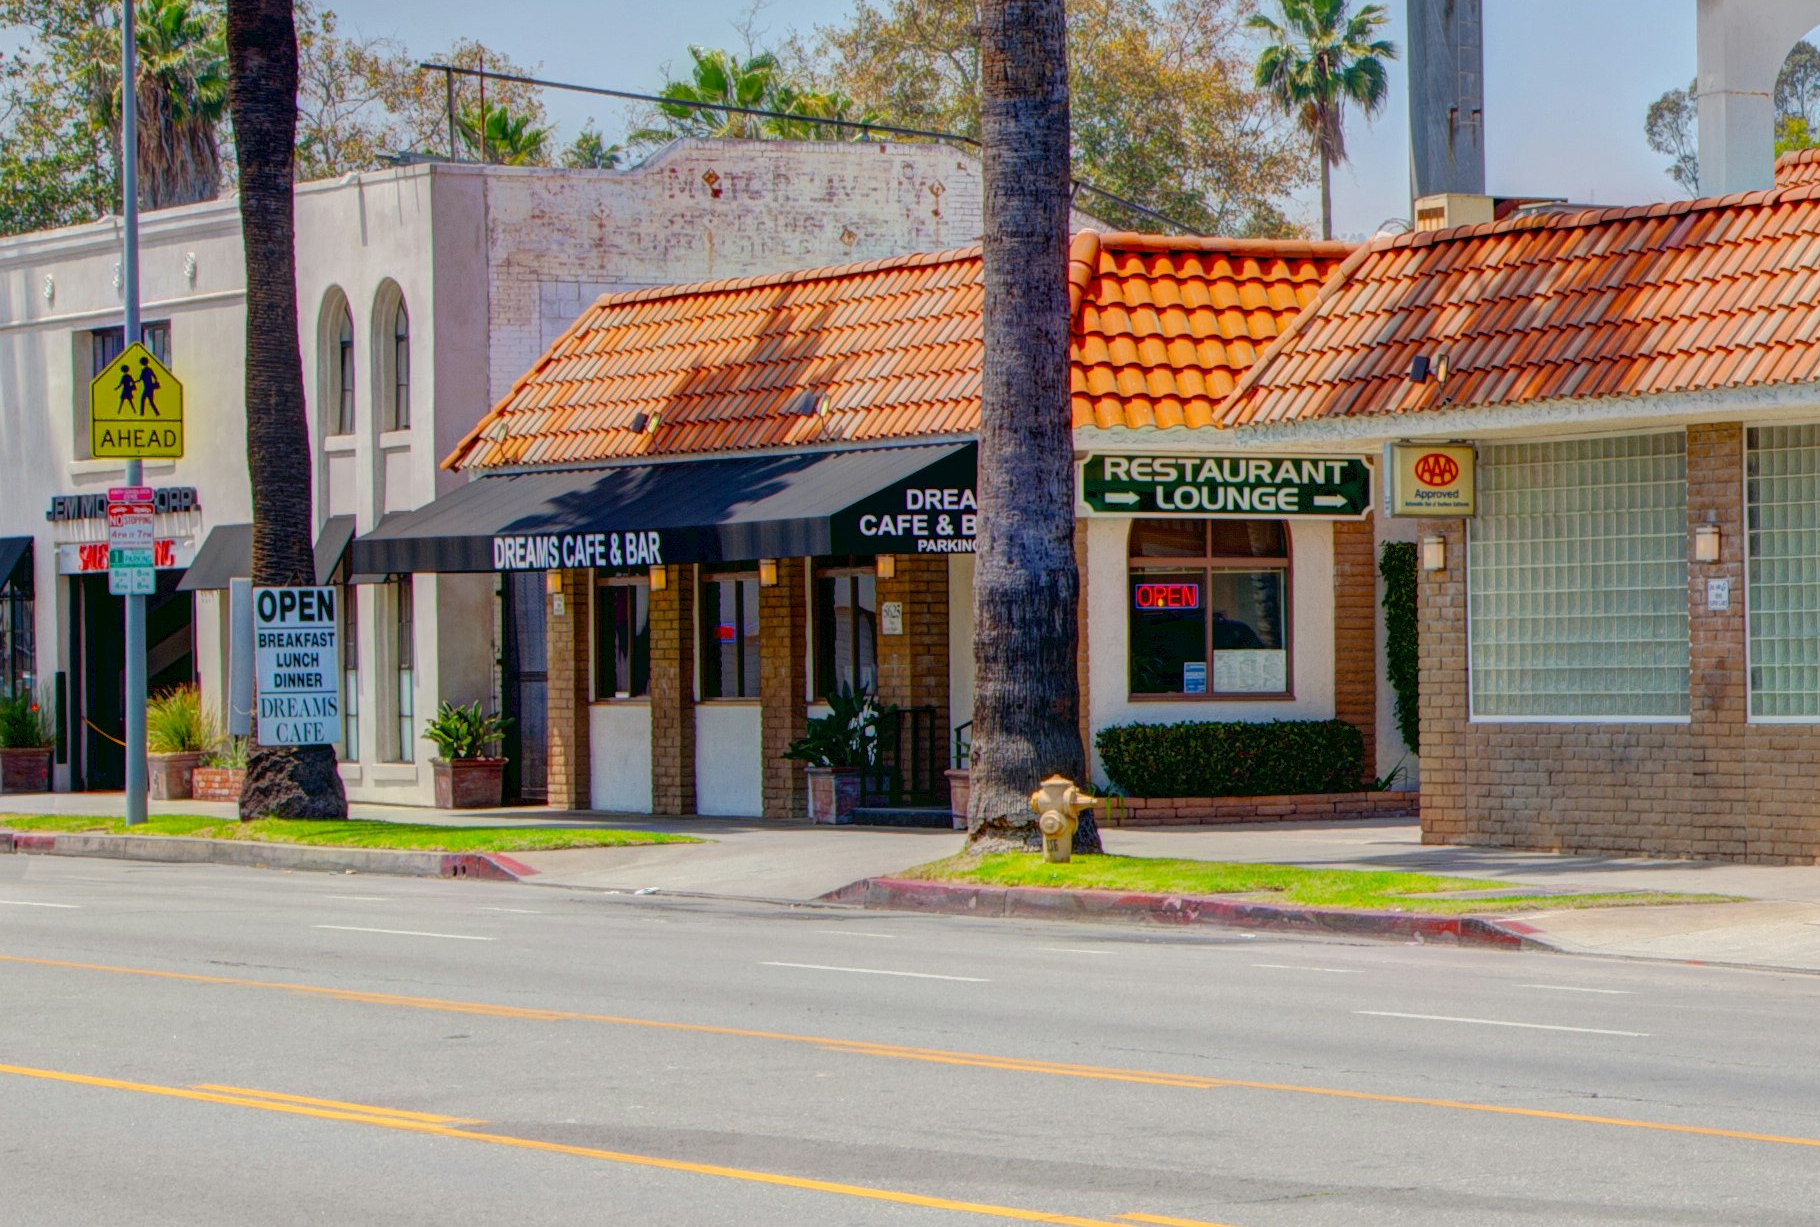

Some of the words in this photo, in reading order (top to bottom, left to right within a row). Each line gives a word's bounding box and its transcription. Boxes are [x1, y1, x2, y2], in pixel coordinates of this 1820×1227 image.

[100, 428, 177, 448] AHEAD
[1104, 457, 1348, 485] RESTAURANT
[1415, 454, 1458, 486] AAA
[906, 489, 976, 510] DREA
[1155, 483, 1300, 512] LOUNGE
[1415, 489, 1459, 500] Approved
[110, 515, 123, 527] NO
[859, 514, 929, 536] CAFE
[935, 514, 954, 536] &
[494, 535, 559, 569] DREAMS
[561, 534, 605, 567] CAFE
[608, 534, 623, 566] &
[626, 532, 662, 565] BAR
[257, 590, 335, 622] OPEN
[1137, 586, 1196, 607] OPEN
[258, 633, 335, 649] BREAKFAST
[276, 653, 319, 669] LUNCH
[273, 673, 323, 689] DINNER
[259, 698, 338, 719] DREAMS
[276, 723, 326, 744] CAFE
